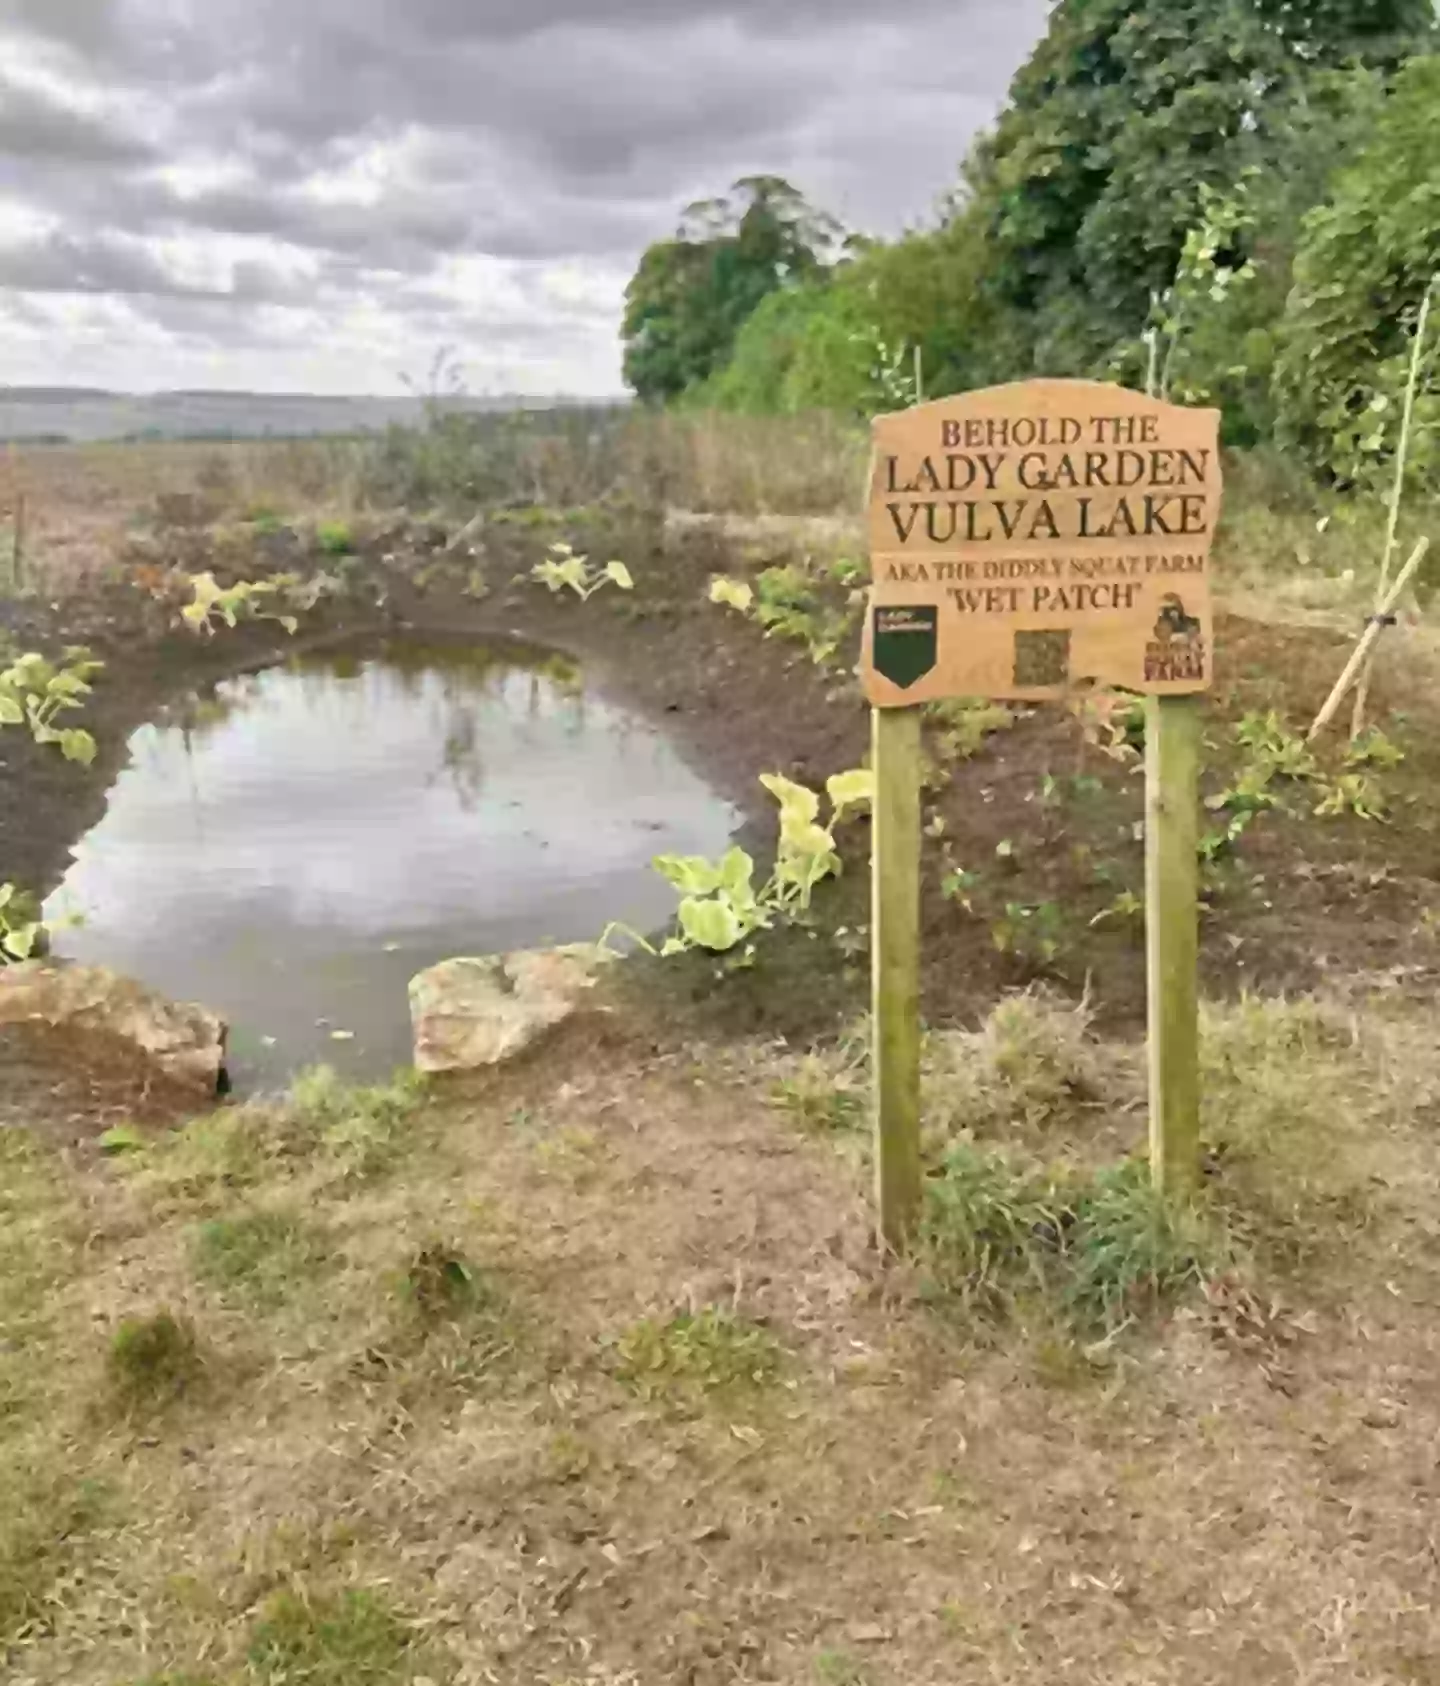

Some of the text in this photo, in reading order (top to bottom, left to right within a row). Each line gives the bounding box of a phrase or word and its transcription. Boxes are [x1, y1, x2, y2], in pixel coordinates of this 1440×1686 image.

[941, 414, 1159, 448] BEHOLD THE
[886, 449, 1211, 493] LADY GARDEN
[886, 494, 1207, 544] VULVA LAKE
[885, 562, 930, 582] AKA
[931, 561, 977, 580] THE
[1069, 555, 1141, 579] SQUAT
[1145, 554, 1204, 573] FARM
